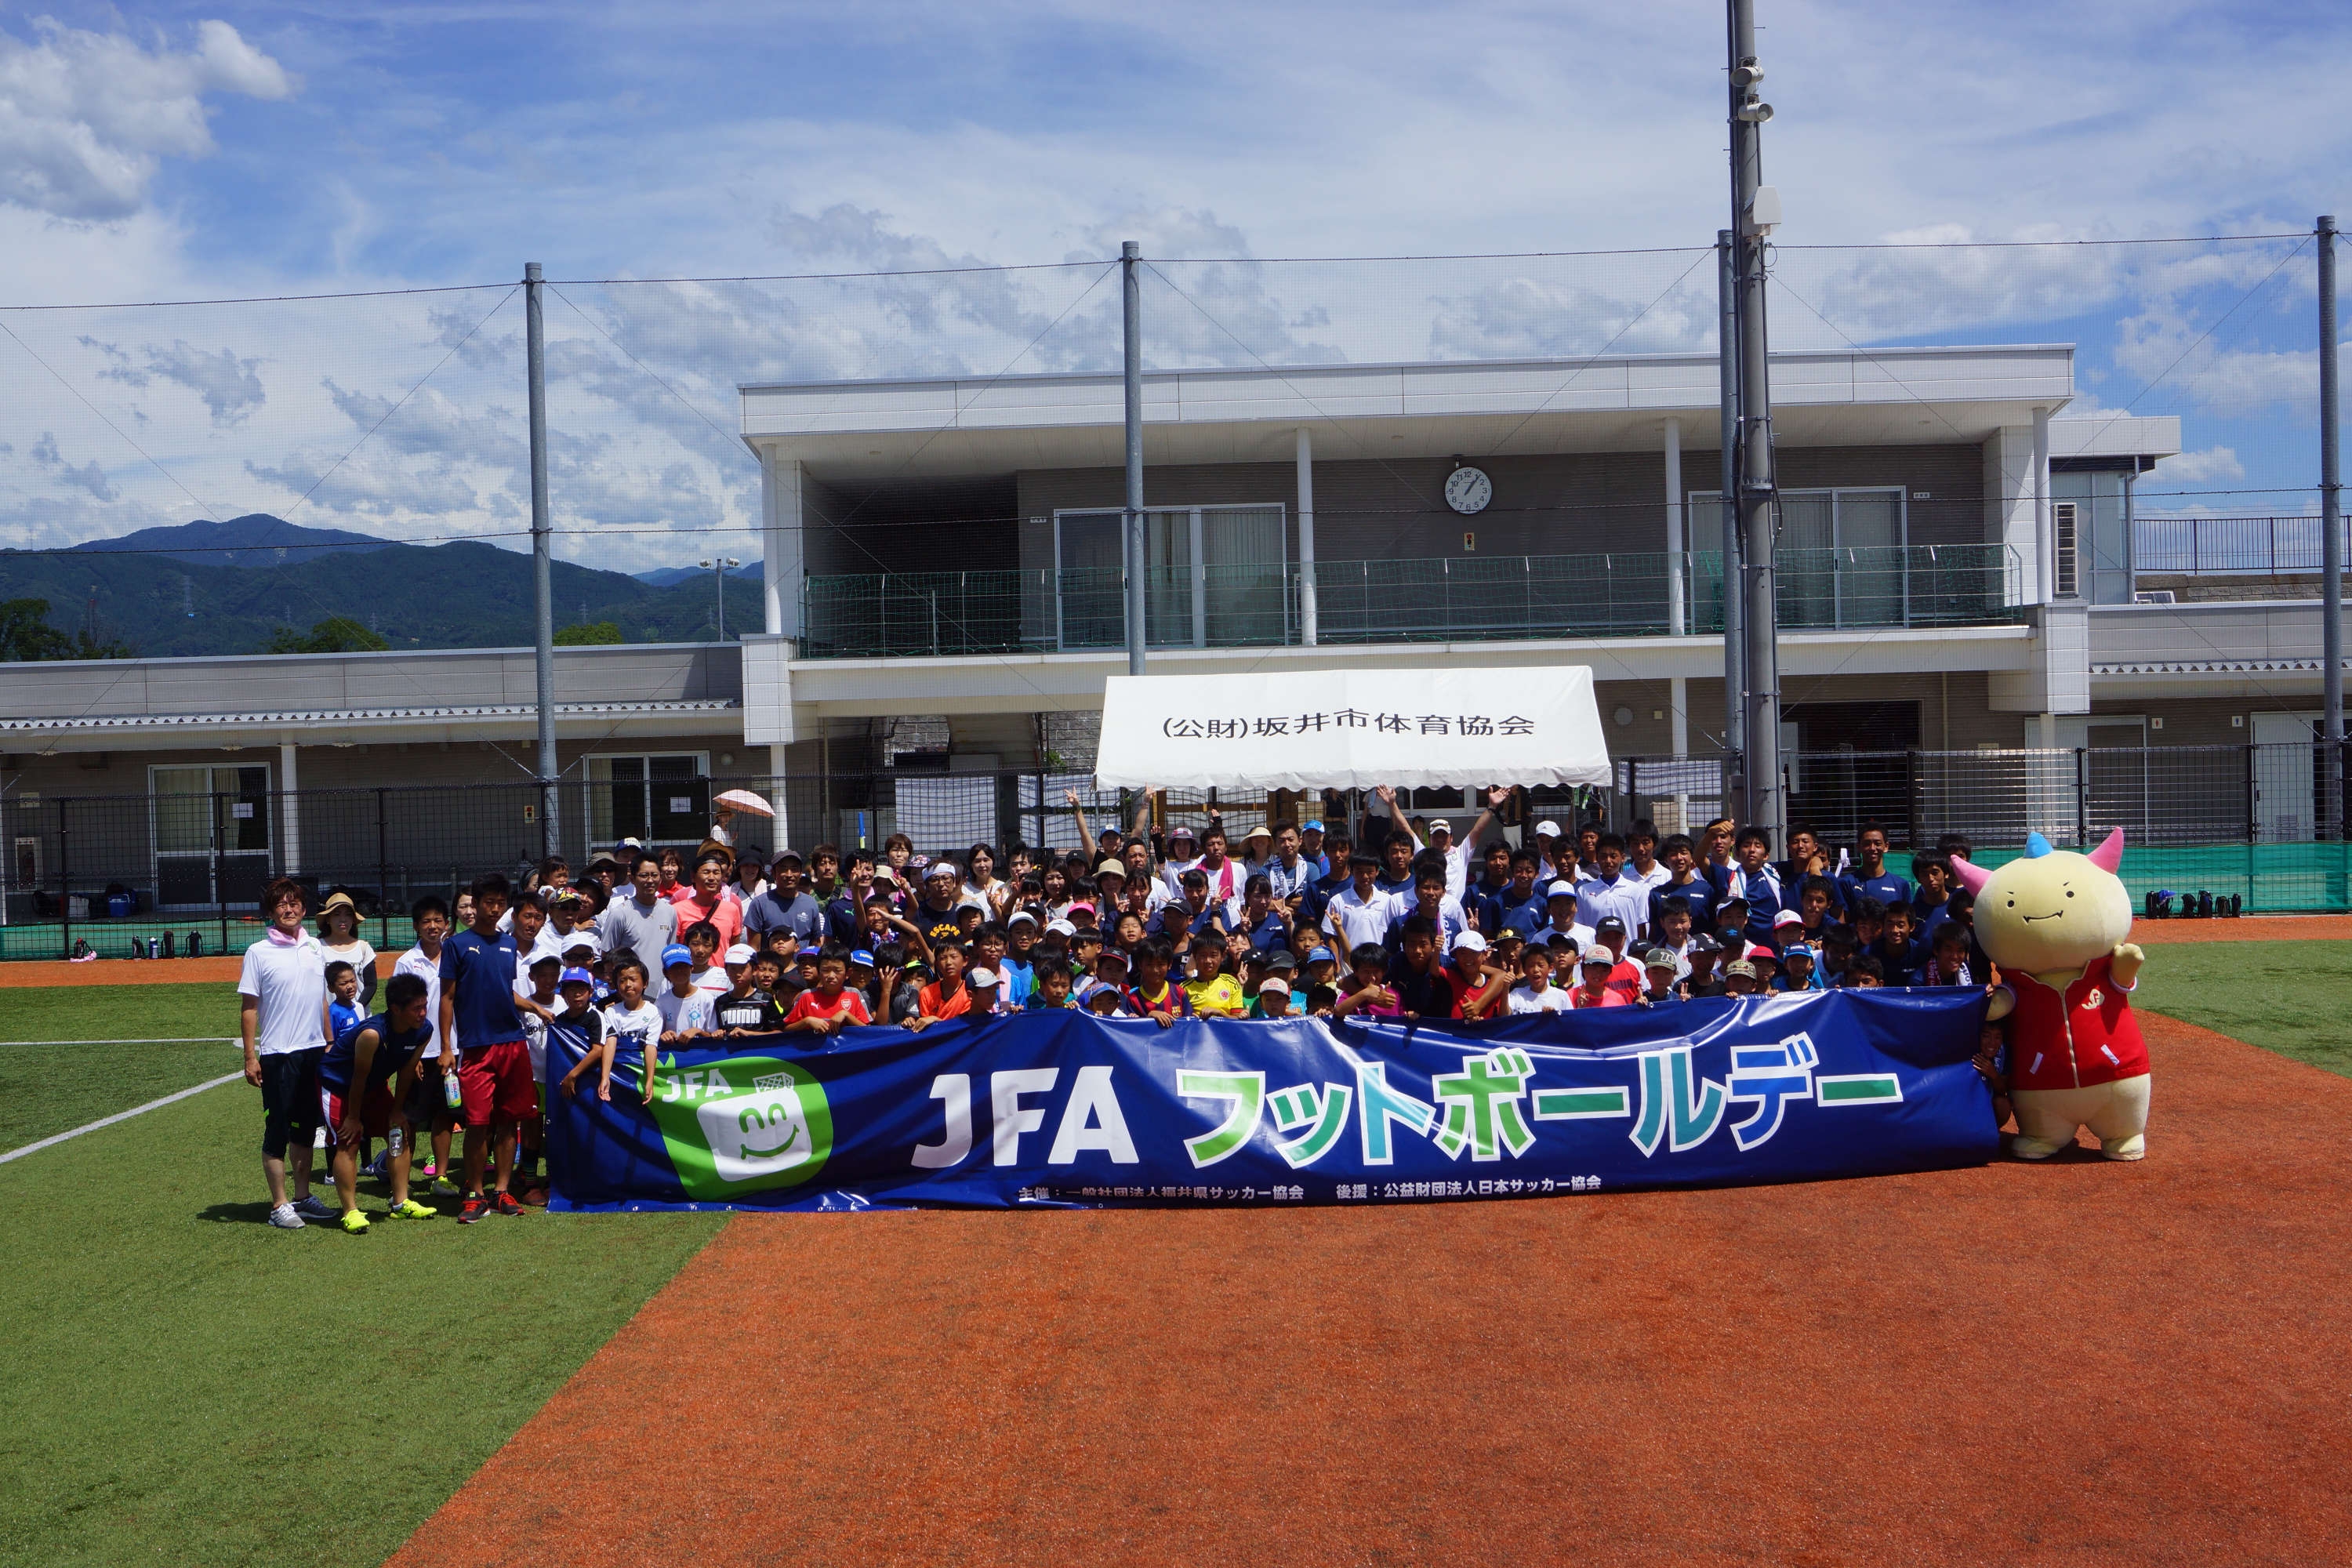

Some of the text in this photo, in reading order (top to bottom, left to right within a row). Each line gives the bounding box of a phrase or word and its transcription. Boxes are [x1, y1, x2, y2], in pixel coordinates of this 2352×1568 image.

[1163, 708, 1535, 739] (公財)坂井市体育協会
[930, 924, 960, 937] ESCAPE
[720, 1009, 760, 1025] PUMA
[662, 1069, 732, 1102] JFA
[911, 1031, 1904, 1169] JFA フットボールデー
[1336, 1174, 1602, 1200] 後援：公益財団法人日本サッカー協会
